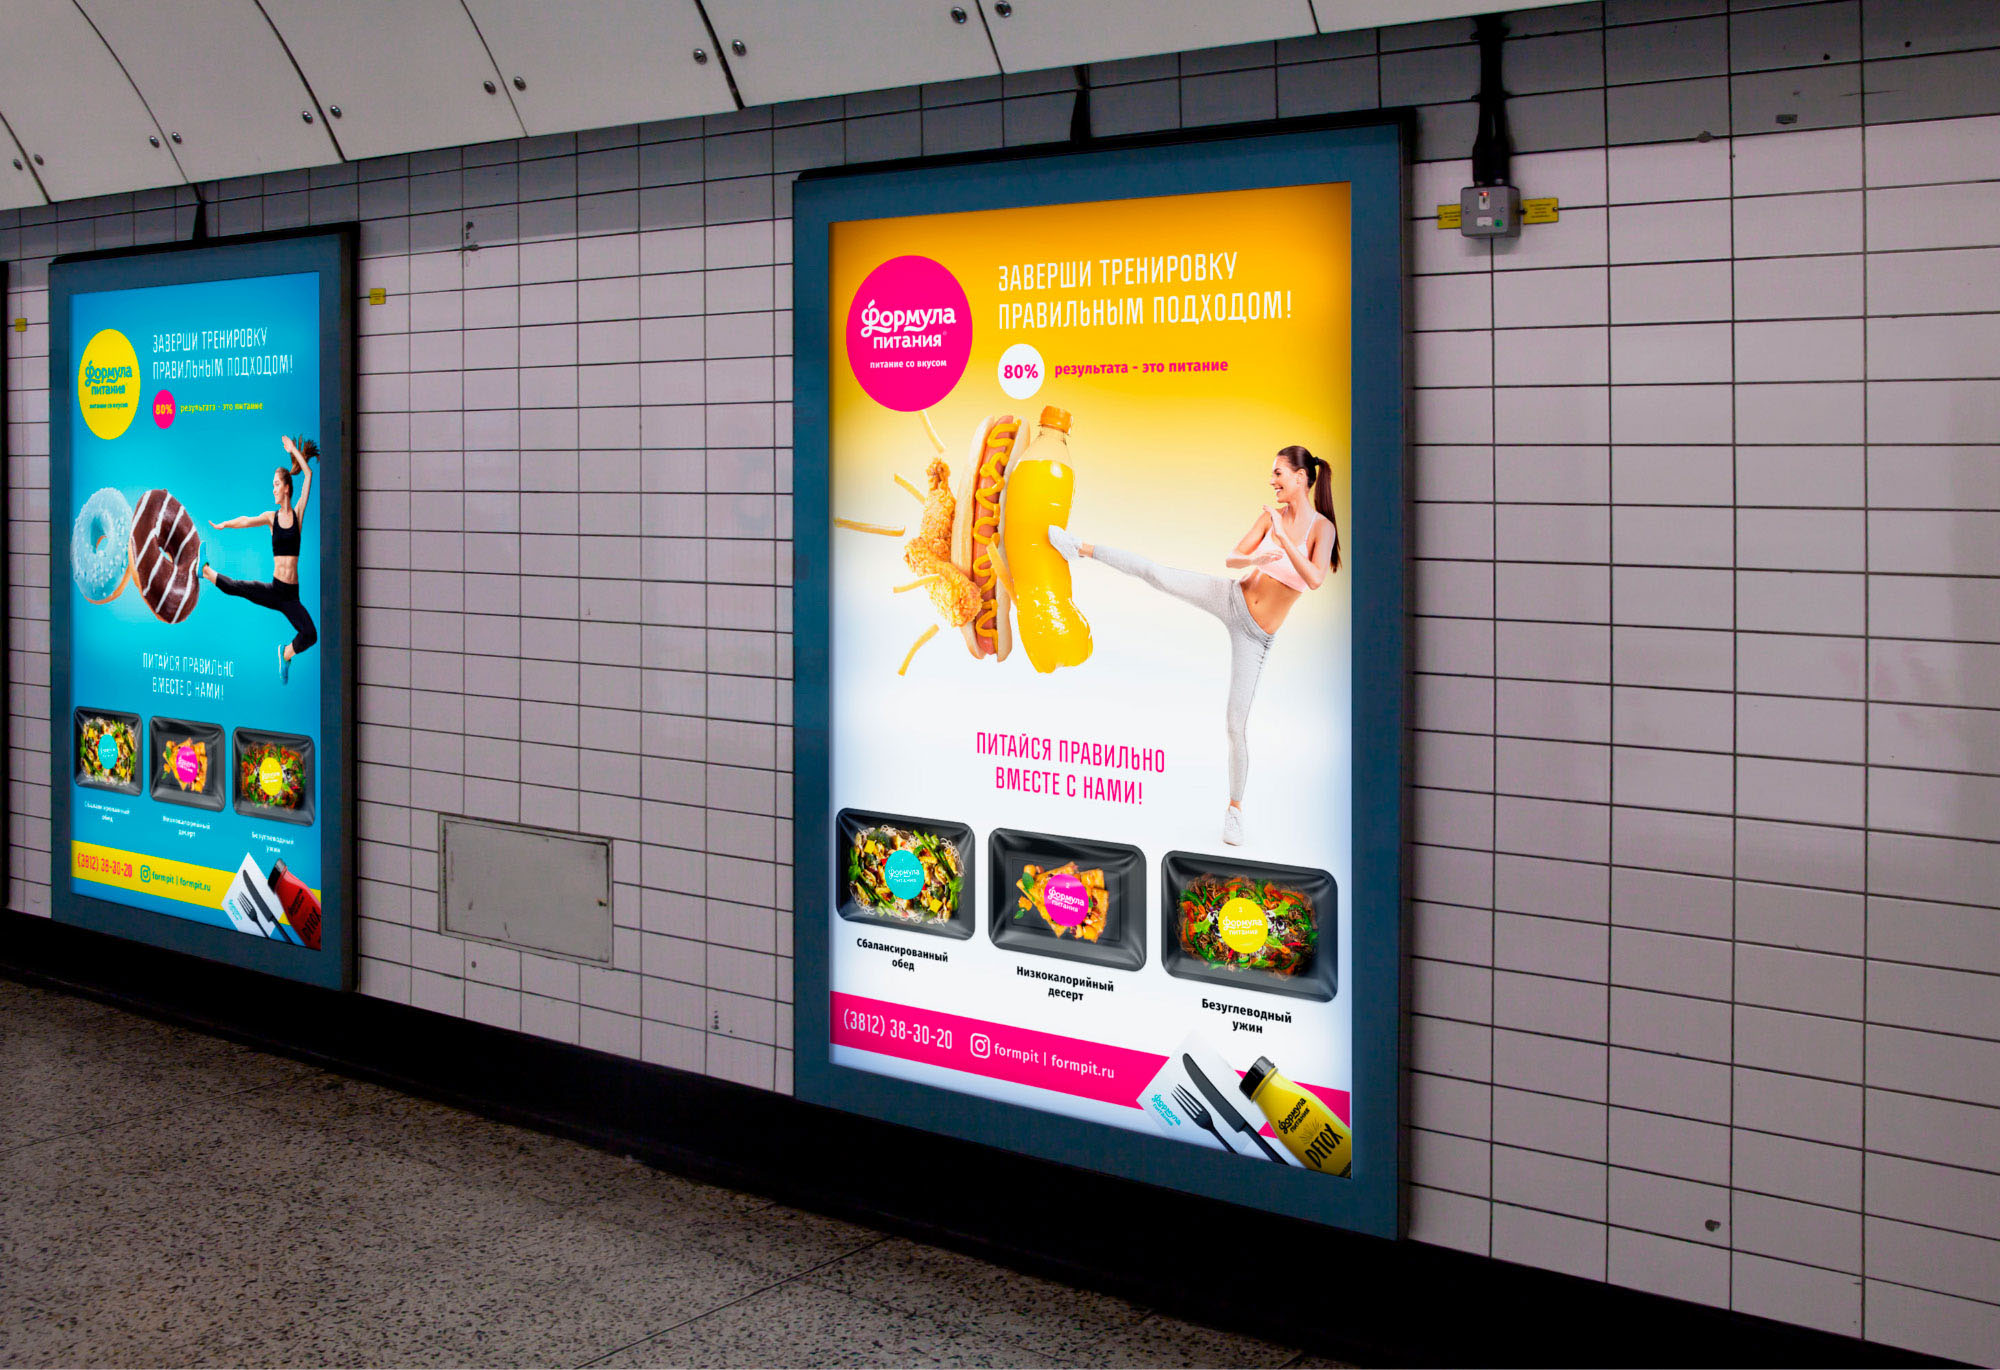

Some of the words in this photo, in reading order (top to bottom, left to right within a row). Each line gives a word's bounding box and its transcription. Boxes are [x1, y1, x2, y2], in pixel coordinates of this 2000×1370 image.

[998, 260, 1092, 292] ЗАВЕРШИ
[1099, 252, 1238, 286] ТРЕНИРОВКУ
[998, 296, 1144, 330] ПРАВИЛЬНЫМ
[1153, 290, 1293, 326] ПОДХОДОМ!
[153, 332, 198, 353] ЗАВЕРШИ
[201, 327, 268, 350] ТРЕНИРОВКУ
[873, 333, 943, 349] питания
[153, 358, 224, 380] ПРАВИЛЬНЫМ
[227, 354, 293, 378] ПОДХОДОМ!
[870, 360, 904, 369] питание
[917, 359, 947, 369] вкусом
[1003, 363, 1039, 380] 80%
[1054, 362, 1129, 378] результата
[1142, 361, 1165, 374] это
[1168, 359, 1229, 373] питание
[155, 404, 173, 415] 80%
[180, 403, 216, 414] результата
[143, 652, 180, 671] ПИТАЙСЯ
[152, 677, 184, 695] ВМЕСТЕ
[186, 680, 192, 697] С
[195, 682, 225, 701] НАМИ!
[976, 731, 1052, 762] ПИТАЙСЯ
[1058, 739, 1165, 774] ПРАВИЛЬНО
[995, 766, 1060, 796] ВМЕСТЕ
[1066, 773, 1076, 797] С
[1083, 774, 1144, 805] НАМИ!
[77, 852, 99, 872] (3812)
[100, 857, 133, 879] 38-30-20
[152, 870, 174, 886] formpit
[180, 877, 211, 893] formpit.ru
[856, 937, 949, 964] Сбалансированный
[891, 958, 915, 973] обед
[1016, 965, 1115, 993] Низкокалорийный
[1048, 985, 1084, 1003] десерт
[1201, 997, 1293, 1025] Безуглеводный
[843, 1008, 886, 1038] (3812)
[889, 1018, 953, 1051] 38-30-20
[1232, 1018, 1263, 1035] ужин
[994, 1042, 1039, 1065] formpit
[1050, 1054, 1115, 1079] formpit.ru
[1305, 1122, 1343, 1169] DETOX
